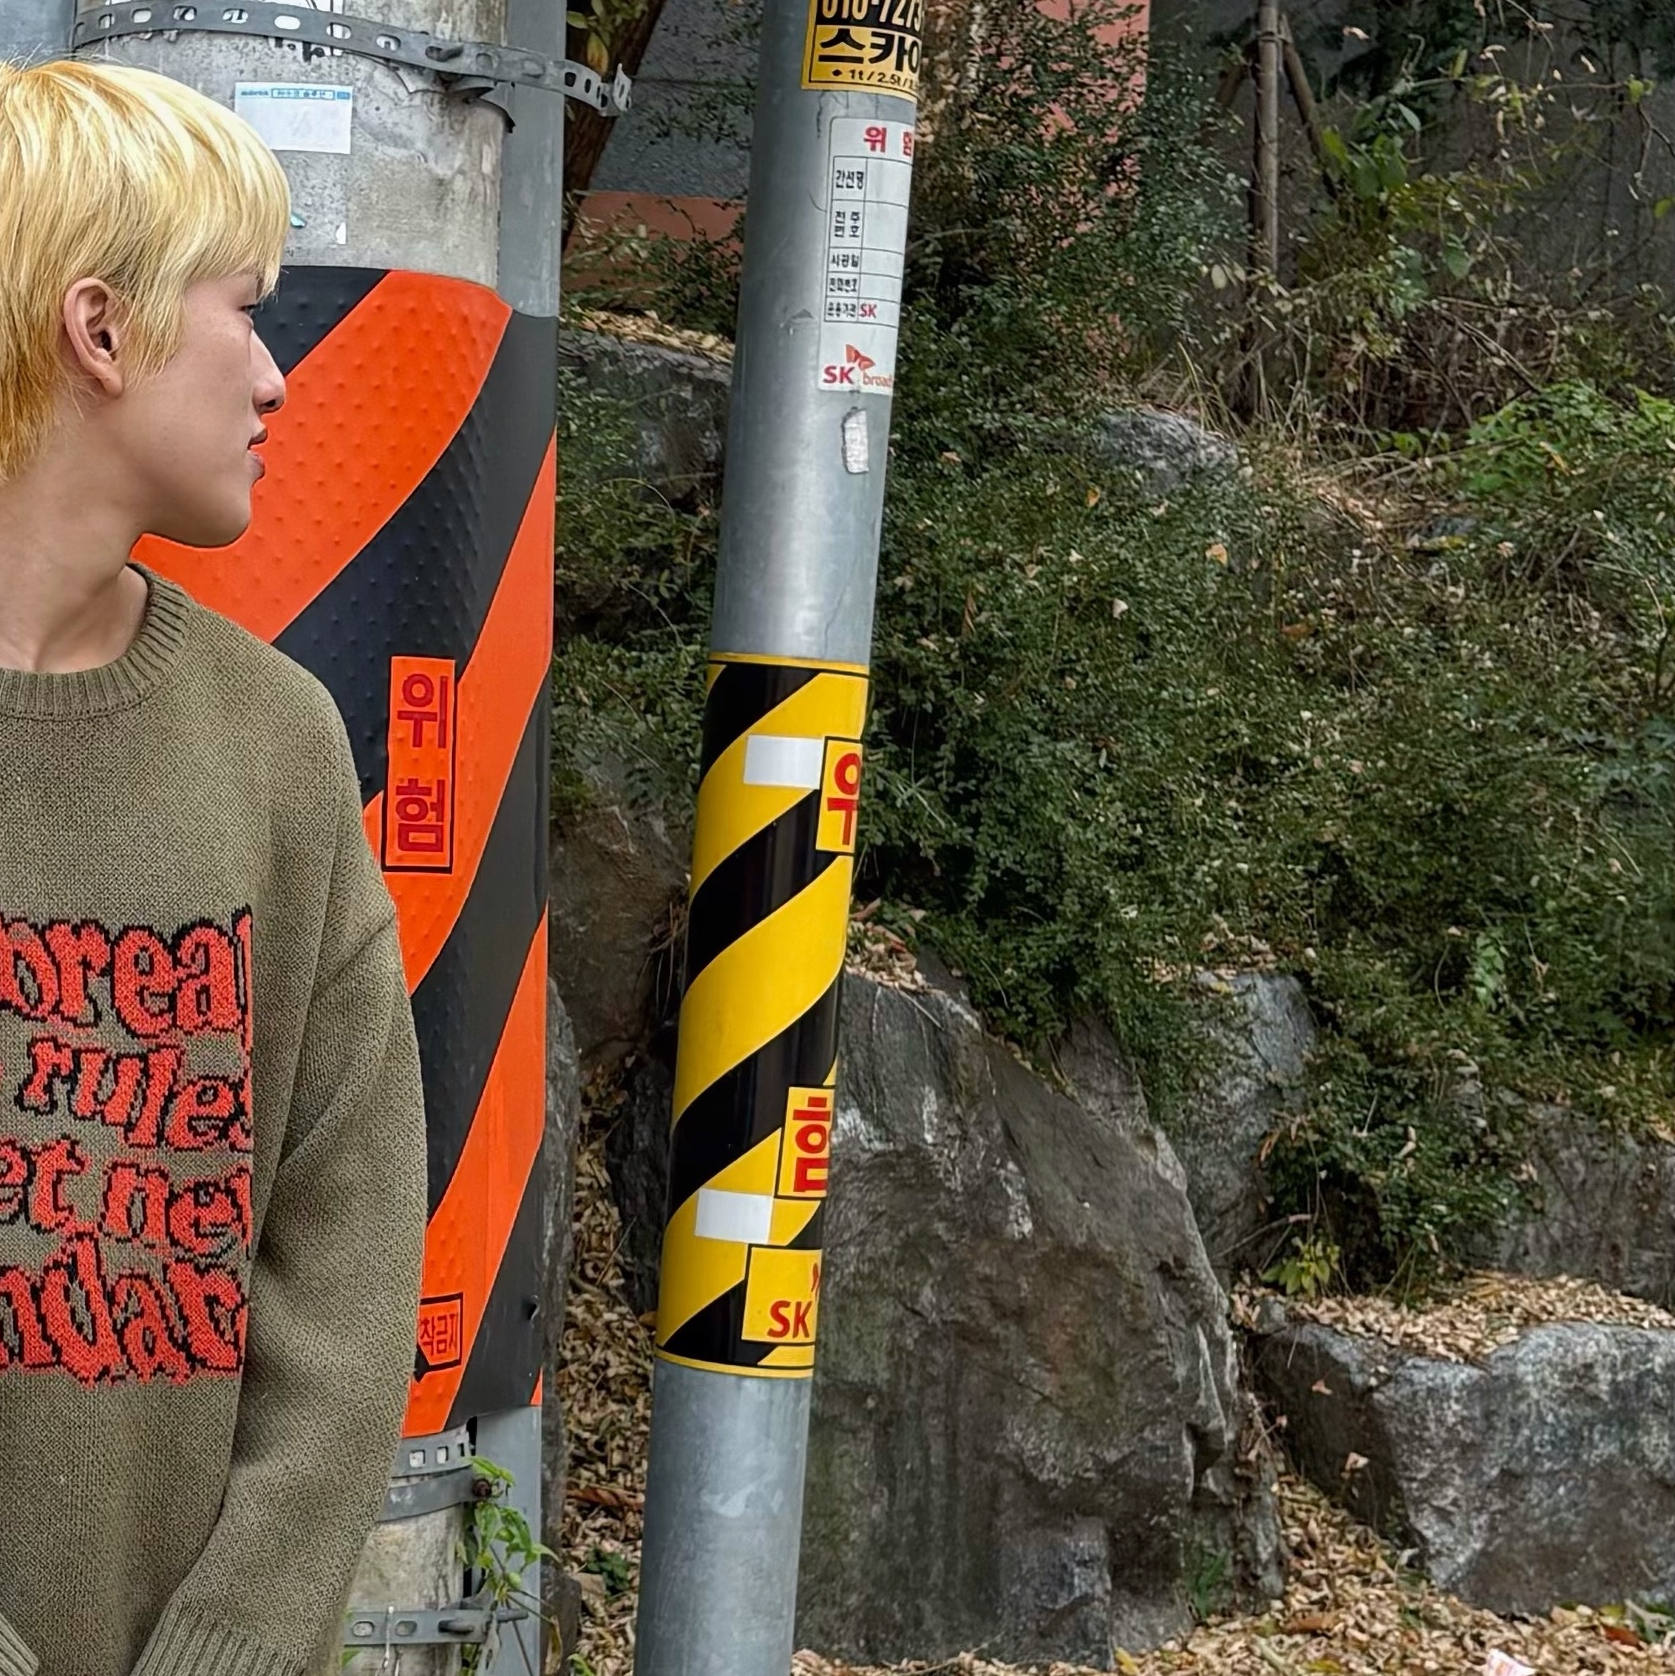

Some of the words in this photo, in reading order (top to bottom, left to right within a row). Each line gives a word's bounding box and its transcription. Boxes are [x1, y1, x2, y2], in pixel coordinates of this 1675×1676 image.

[859, 303, 877, 318] SK
[823, 365, 855, 385] SK
[395, 673, 449, 853] 위험
[767, 1300, 812, 1339] SK
